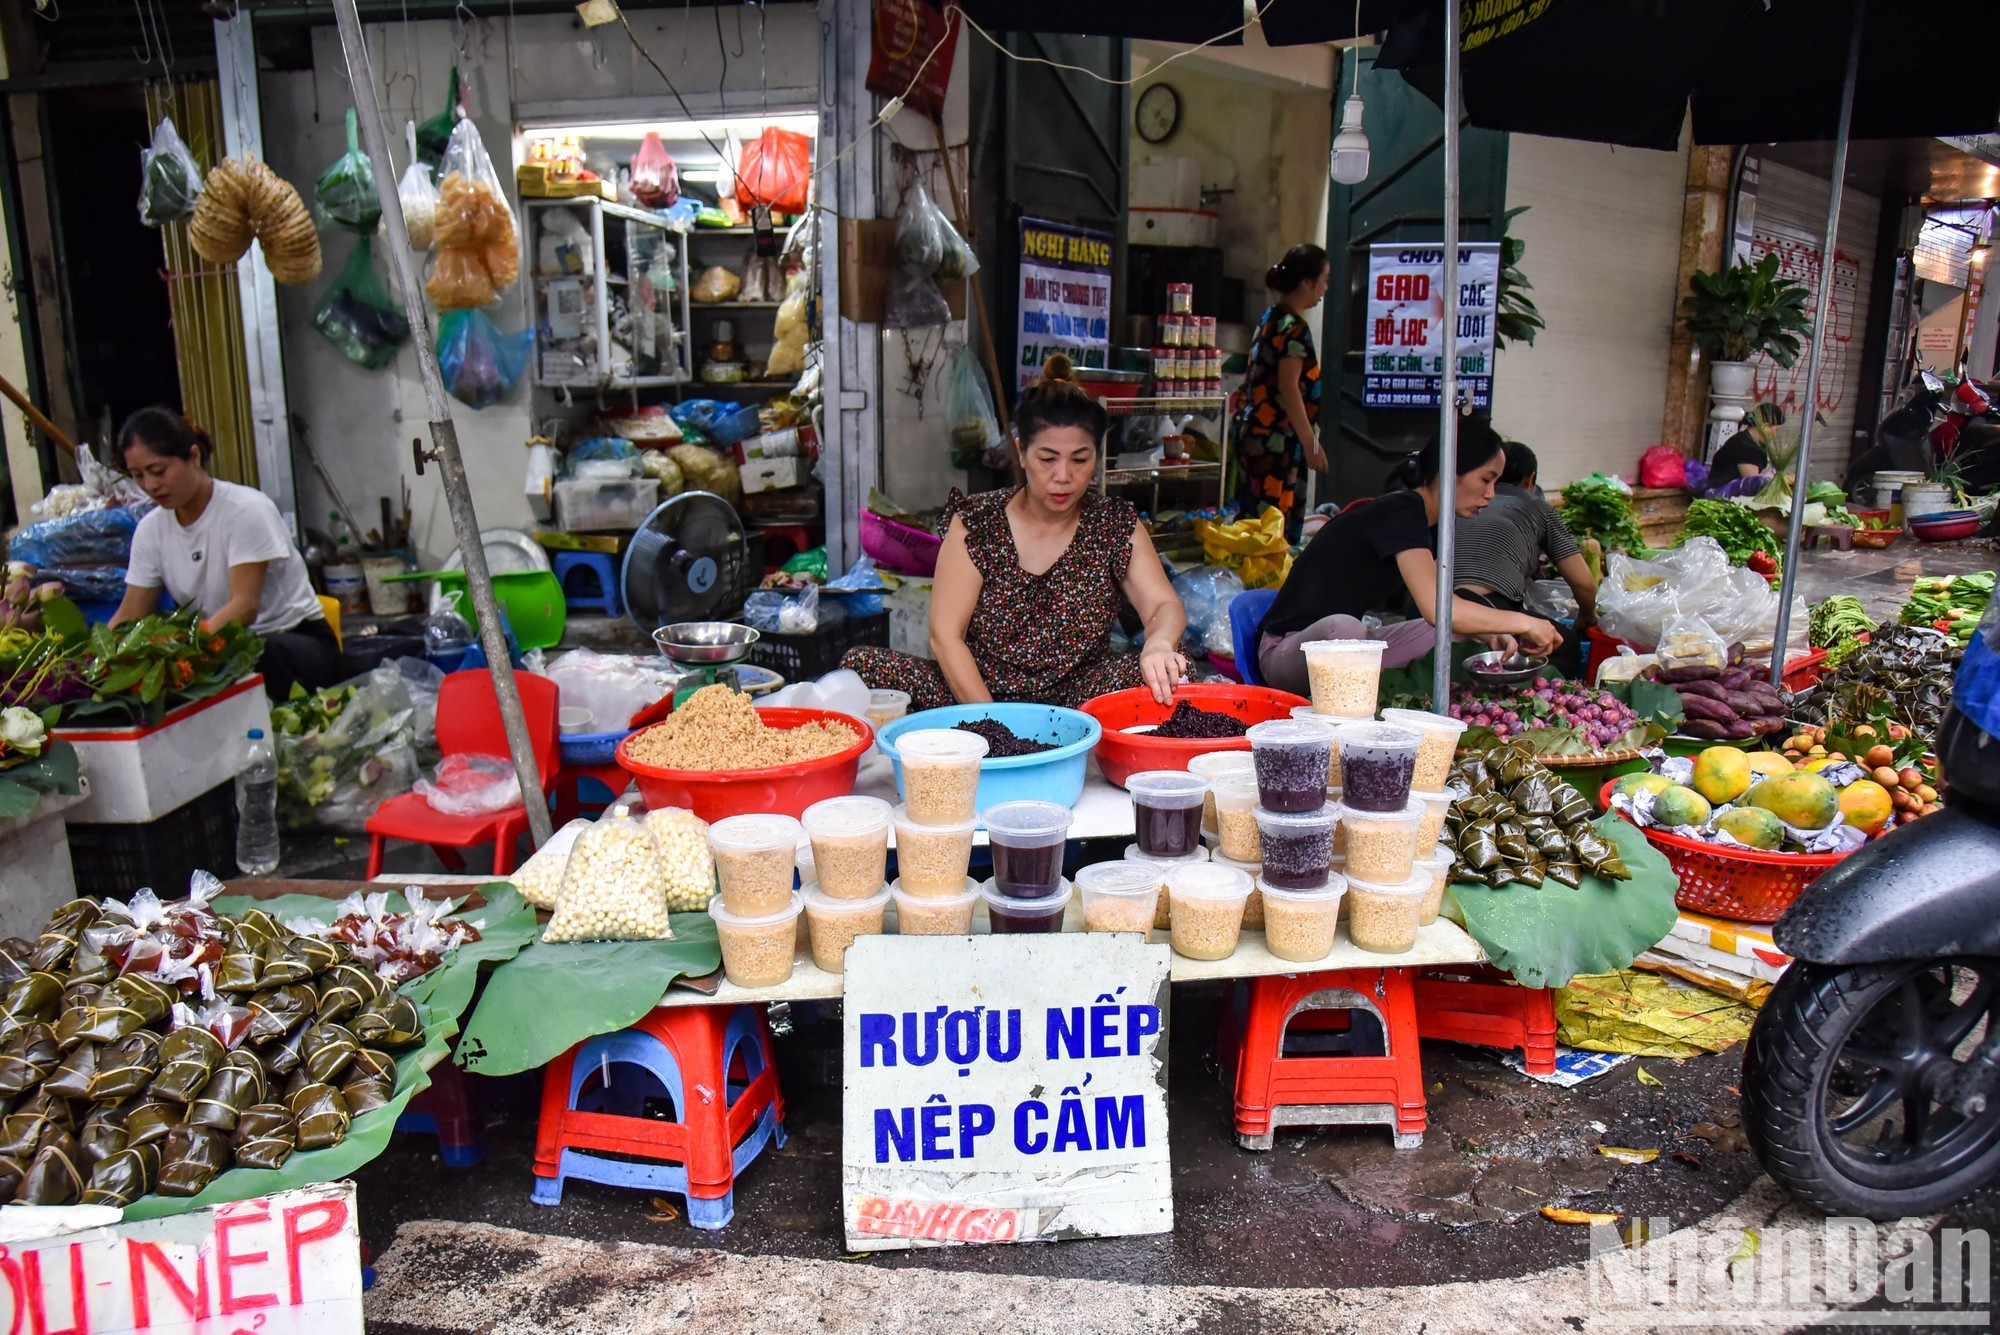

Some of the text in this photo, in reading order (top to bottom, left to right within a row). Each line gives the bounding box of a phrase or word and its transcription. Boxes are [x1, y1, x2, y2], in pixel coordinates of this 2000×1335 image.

[1398, 250, 1472, 264] CHUYN
[1376, 274, 1430, 307] GẠO
[1459, 280, 1486, 307] CÁC
[1456, 315, 1486, 343] LOẠI
[1381, 378, 1392, 390] 12
[1377, 393, 1391, 404] 024
[860, 986, 1163, 1078] RƯỢU NẾP
[1013, 1072, 1148, 1155] CẨM
